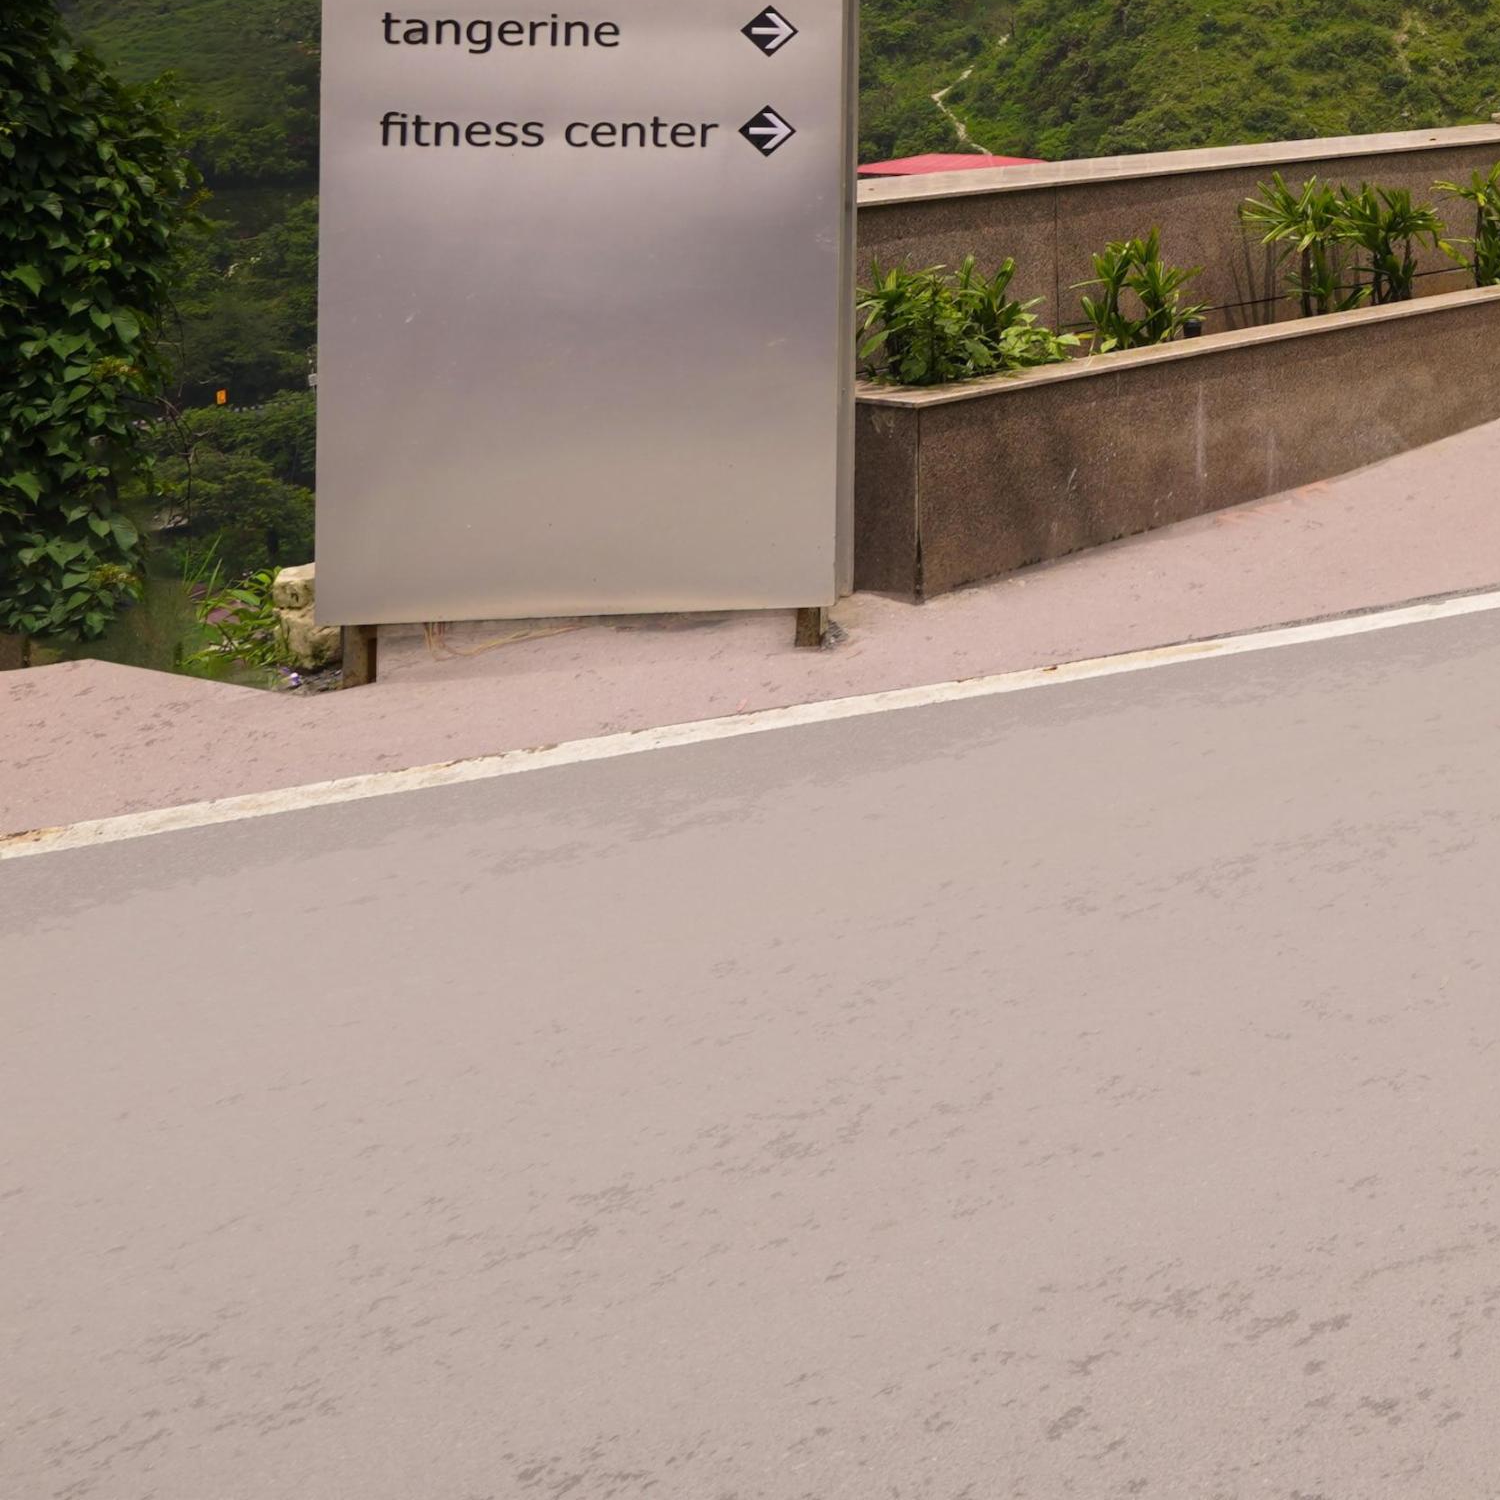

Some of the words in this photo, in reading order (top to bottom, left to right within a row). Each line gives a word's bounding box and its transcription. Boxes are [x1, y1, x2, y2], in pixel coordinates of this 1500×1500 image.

[381, 12, 620, 54] tangerine
[380, 112, 544, 147] fitness
[564, 116, 719, 148] center
